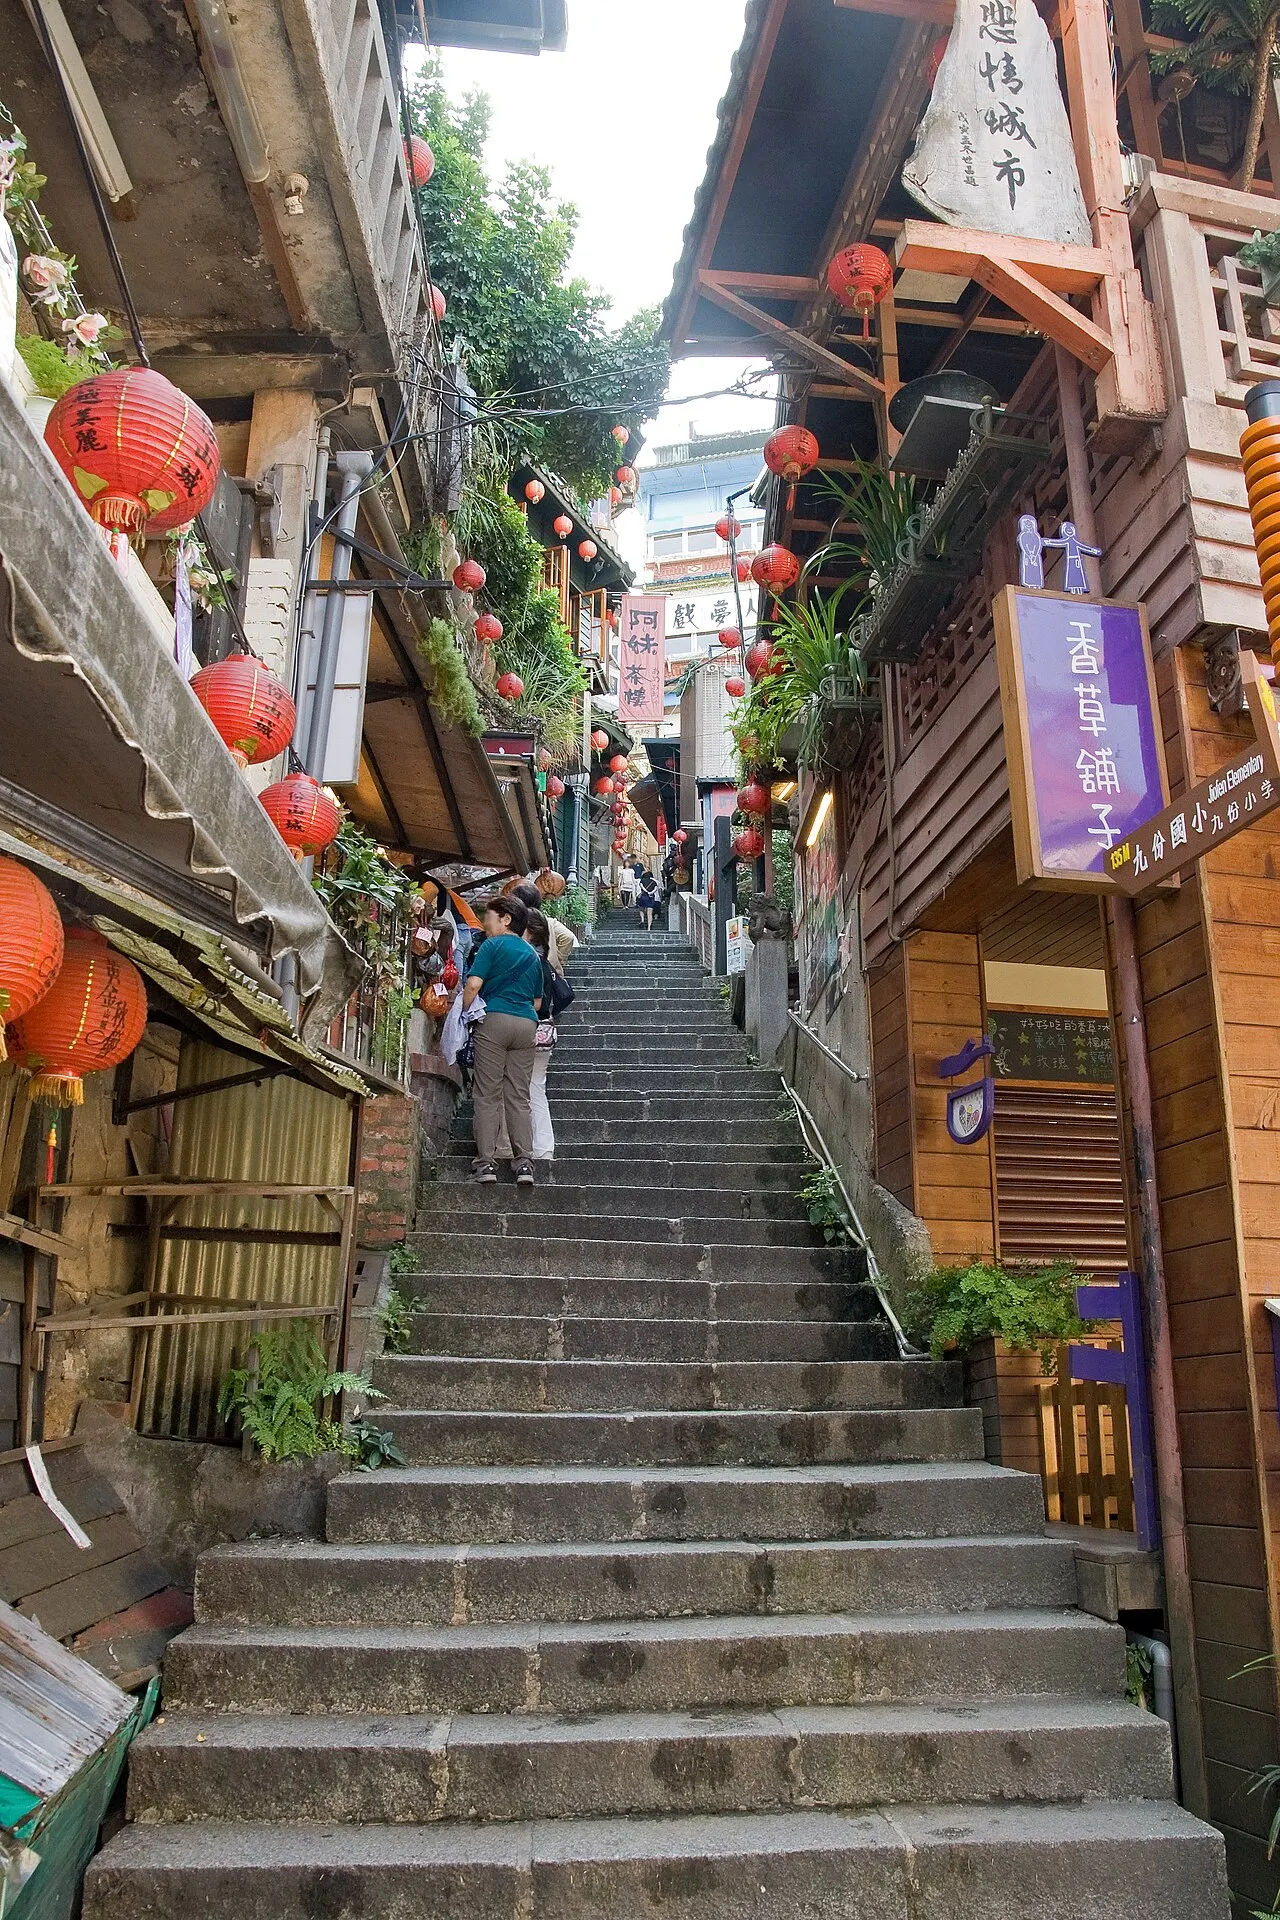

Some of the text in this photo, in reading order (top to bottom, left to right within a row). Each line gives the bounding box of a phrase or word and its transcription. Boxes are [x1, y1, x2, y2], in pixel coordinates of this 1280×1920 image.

[979, 0, 1037, 211] 悲情城市
[624, 609, 659, 707] 阿妹茶樓
[1066, 621, 1121, 850] 香草舖子
[1226, 754, 1264, 791] Elementary
[1133, 802, 1208, 876] 九份國小
[1020, 1018, 1110, 1035] 好好吃的香草冰
